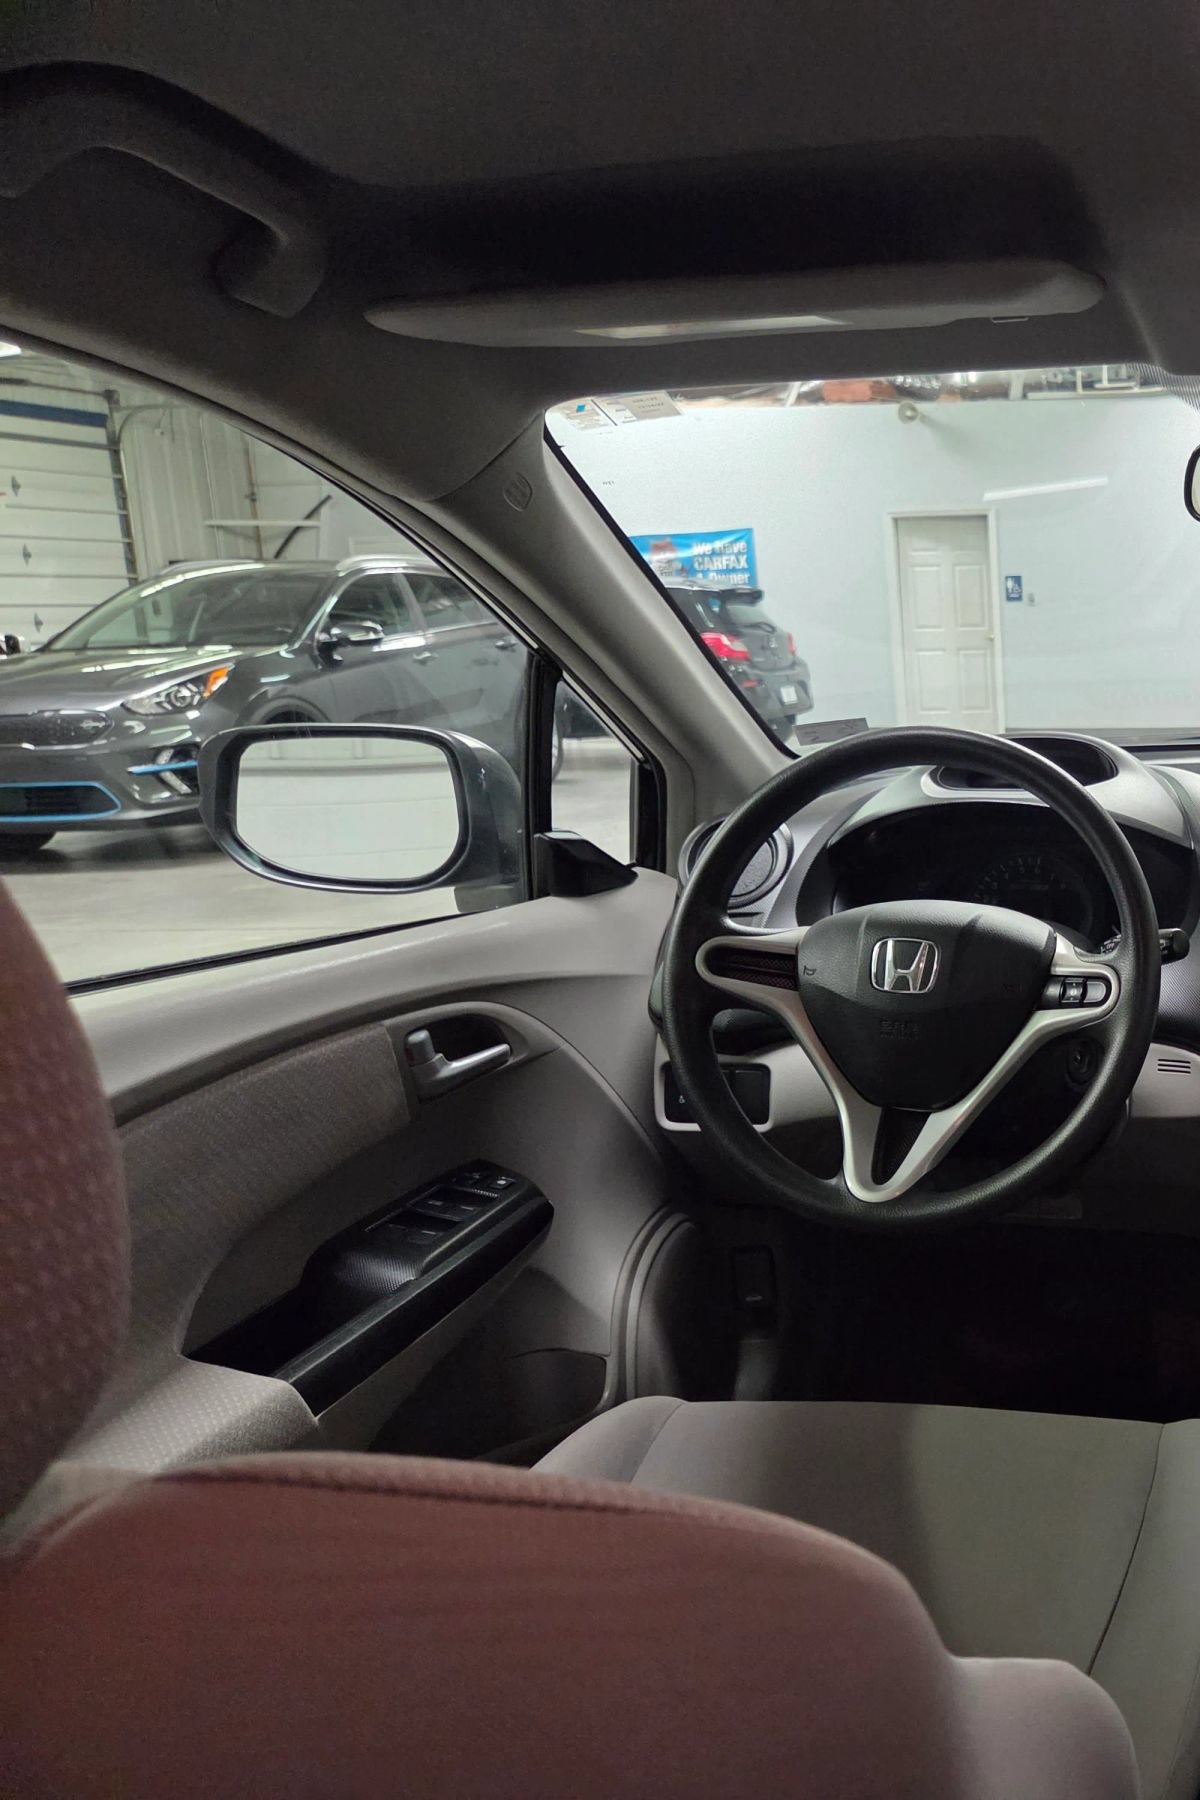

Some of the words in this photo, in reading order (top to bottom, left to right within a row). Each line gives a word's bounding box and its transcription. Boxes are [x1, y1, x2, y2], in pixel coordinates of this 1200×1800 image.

[694, 543, 712, 555] We
[714, 541, 747, 554] have
[693, 554, 748, 571] CARFAX
